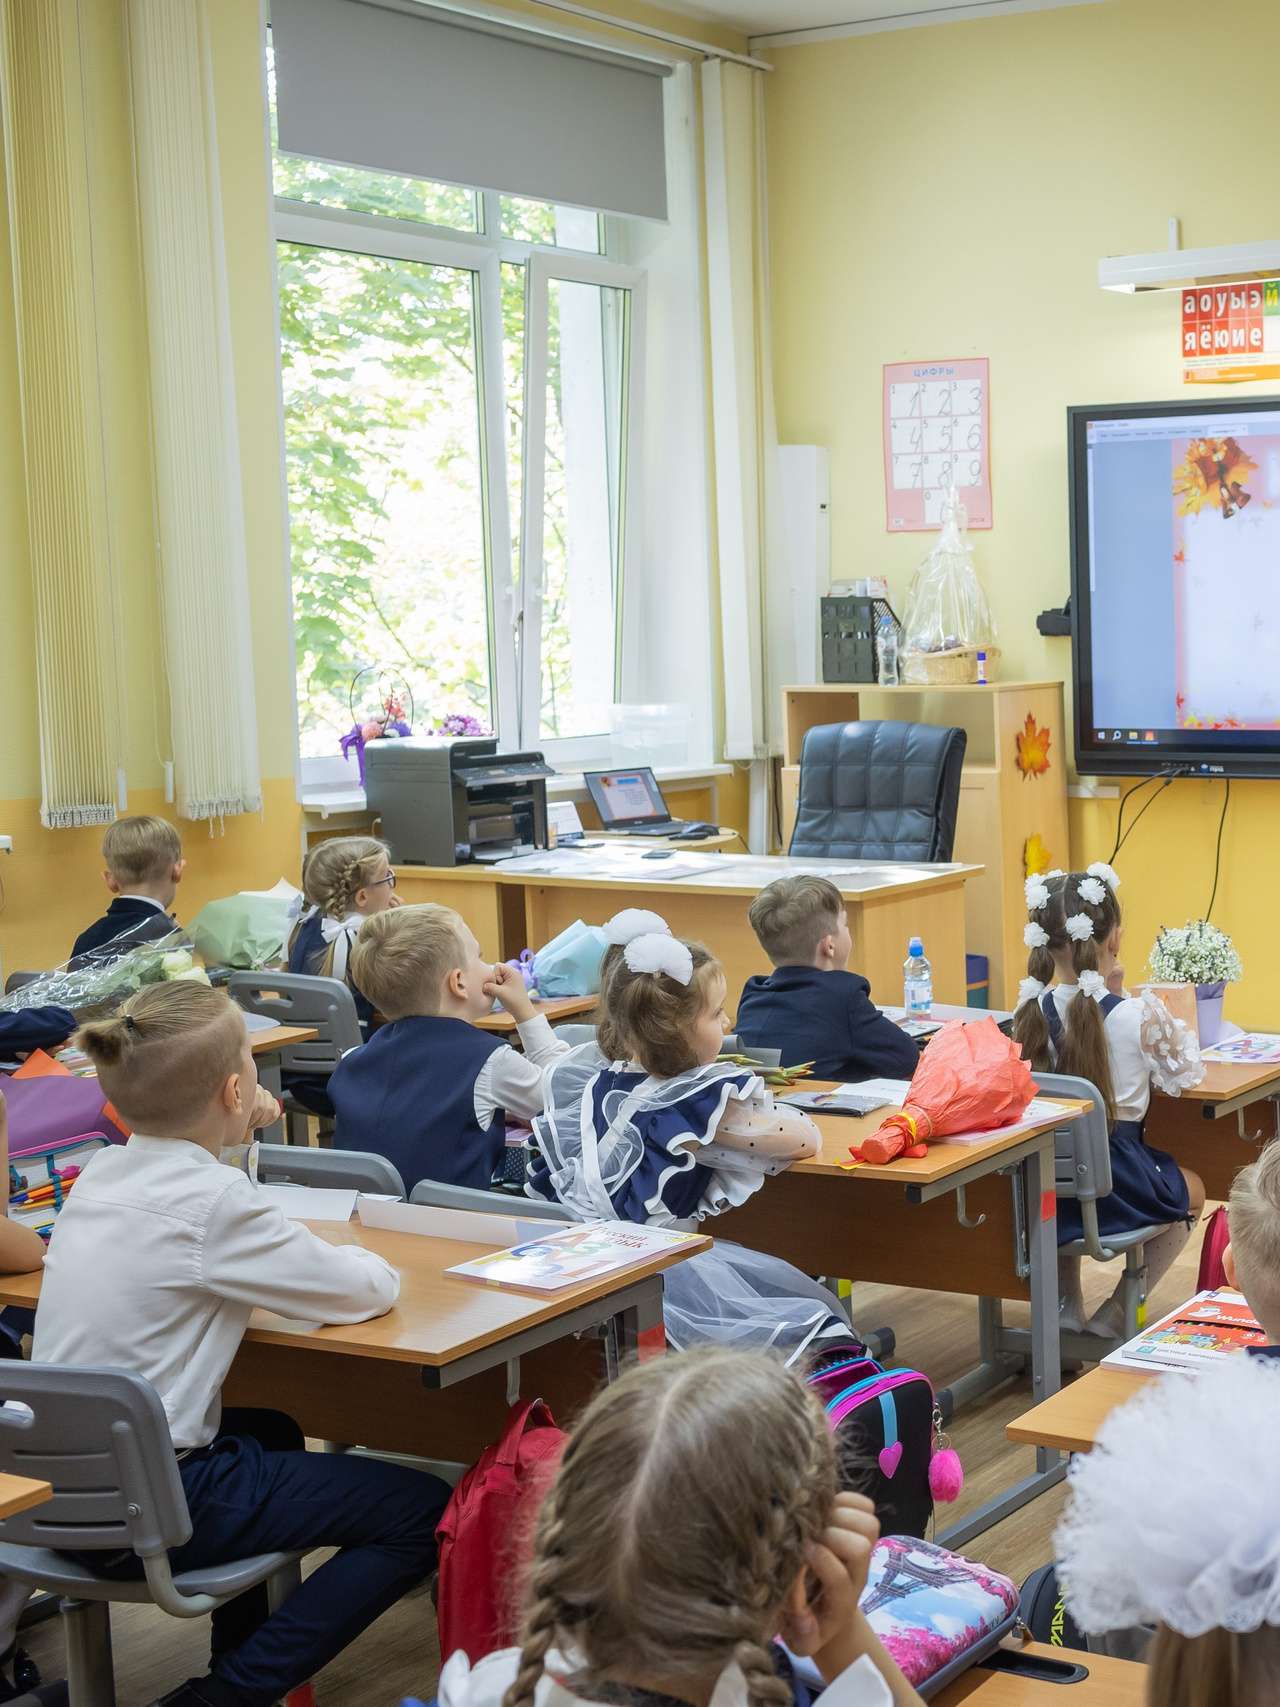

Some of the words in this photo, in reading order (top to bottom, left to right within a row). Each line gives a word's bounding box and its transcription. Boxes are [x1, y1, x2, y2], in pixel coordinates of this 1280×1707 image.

[913, 367, 954, 378] ЦИФРЫ
[892, 385, 896, 394] 1
[921, 384, 927, 392] 2
[952, 382, 958, 391] 3
[909, 390, 919, 417] 1
[938, 389, 951, 416] 2
[968, 387, 982, 415] 3
[892, 421, 897, 429] 4
[923, 420, 928, 428] 5
[953, 418, 959, 427] 6
[909, 426, 921, 453] 4
[939, 425, 952, 451] 5
[967, 423, 981, 450] 6
[894, 456, 899, 465] 7
[923, 455, 929, 464] 8
[953, 454, 958, 463] 9
[910, 462, 922, 489] 7
[937, 461, 951, 488] 8
[968, 459, 982, 486] 9
